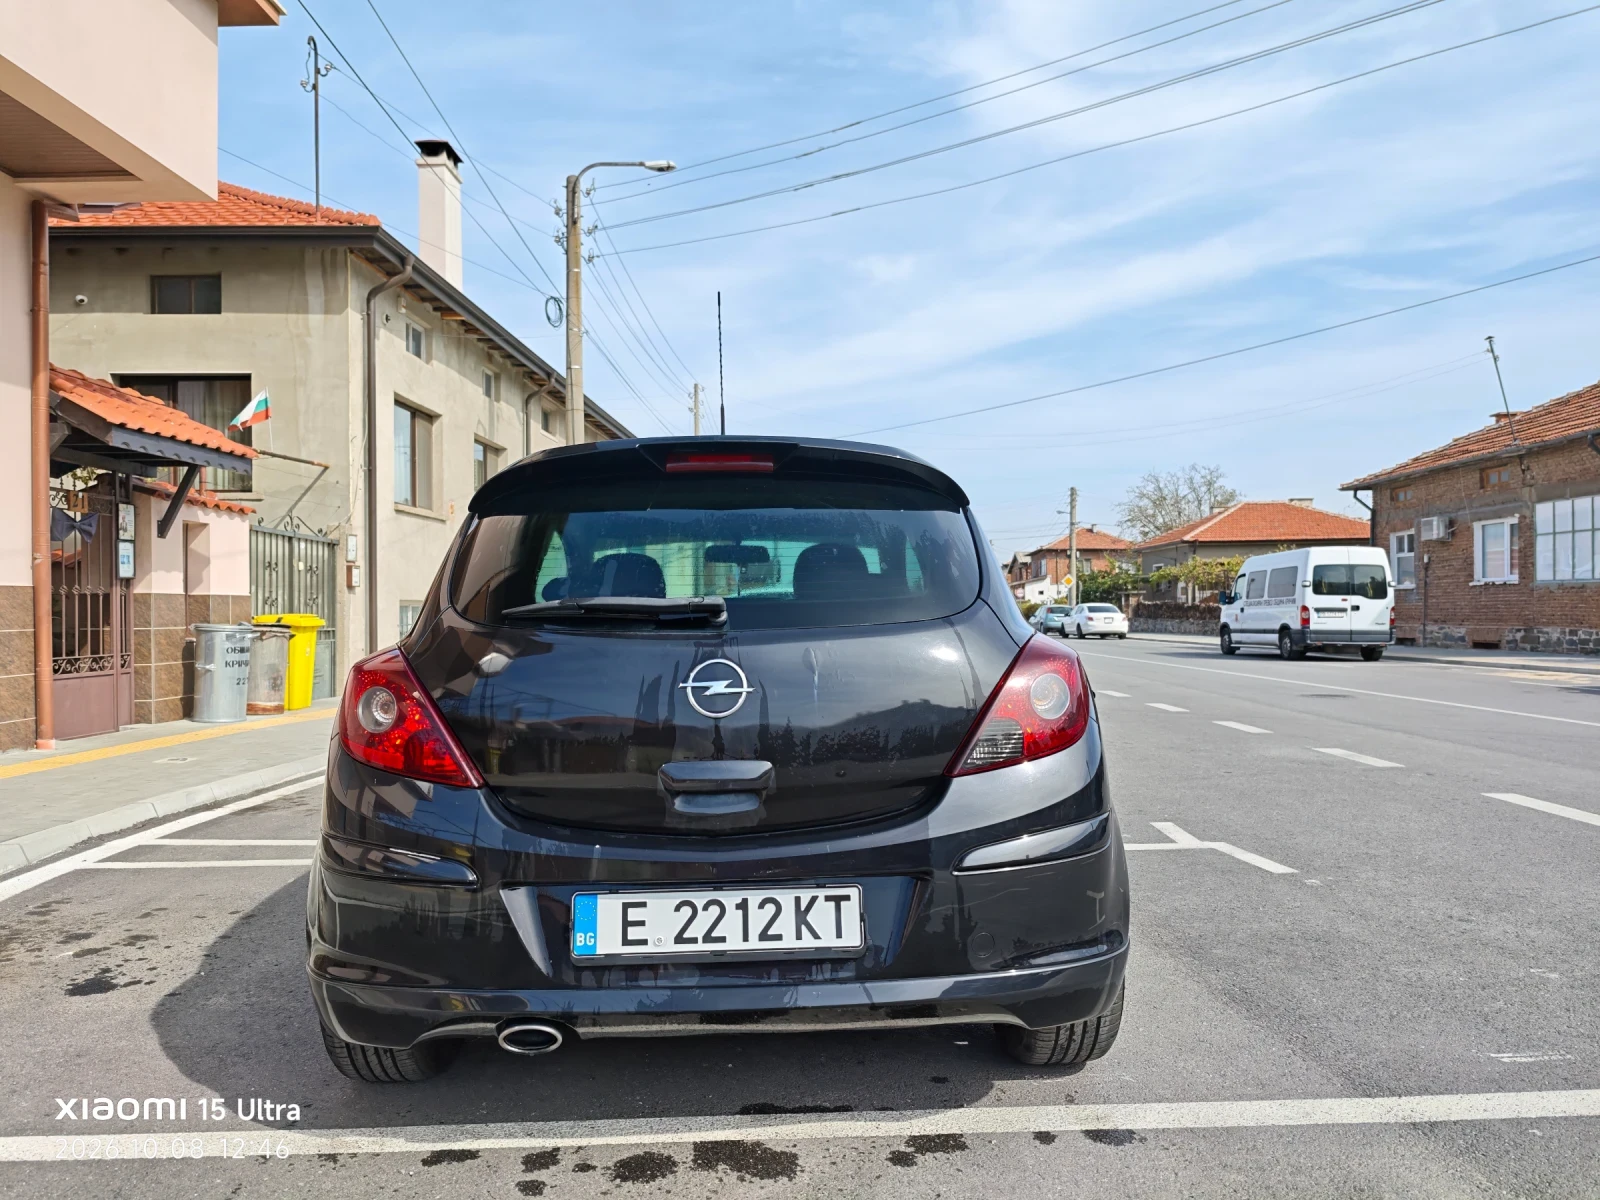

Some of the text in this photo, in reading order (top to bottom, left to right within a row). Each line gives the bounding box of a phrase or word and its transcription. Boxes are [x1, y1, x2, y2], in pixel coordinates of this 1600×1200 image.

[72, 493, 86, 510] 21
[236, 677, 249, 686] 22
[621, 901, 649, 947] E
[576, 932, 595, 947] BG
